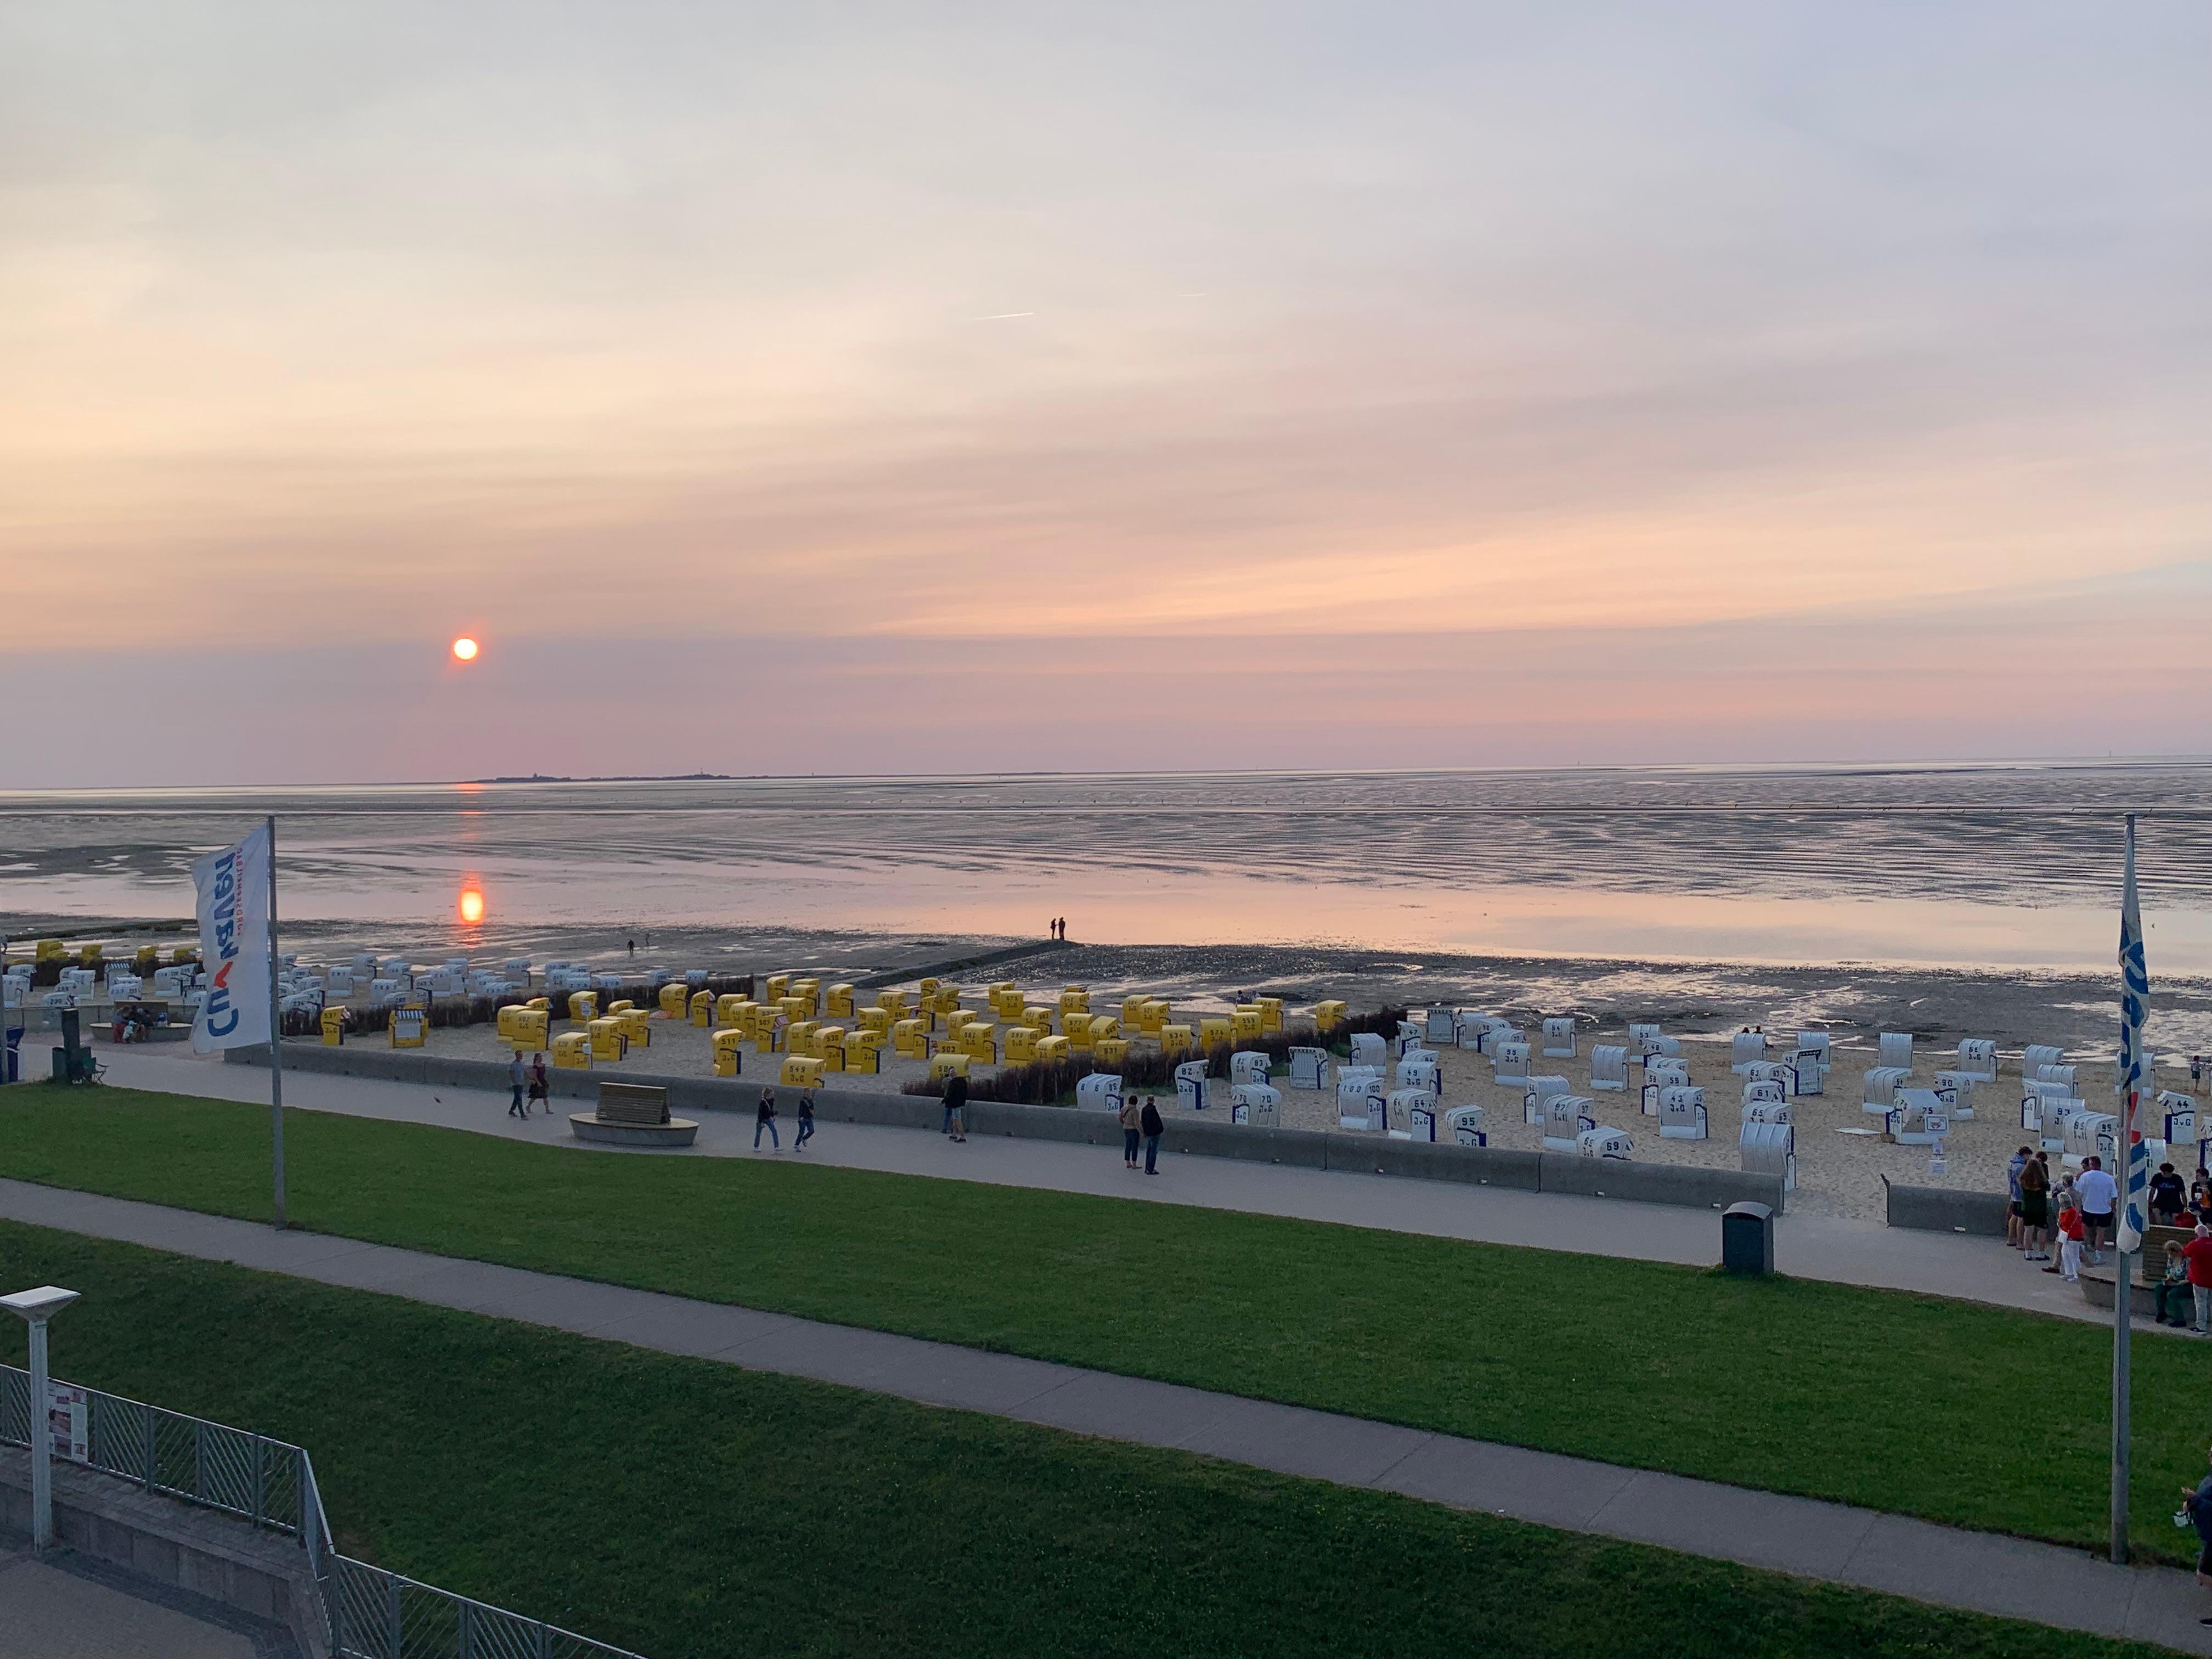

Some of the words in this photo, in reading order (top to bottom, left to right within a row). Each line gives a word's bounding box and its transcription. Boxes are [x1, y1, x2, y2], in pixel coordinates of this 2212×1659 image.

[1369, 1085, 1380, 1093] 100
[1757, 1089, 1769, 1098] 61
[1261, 1095, 1272, 1103] 70
[1414, 1099, 1425, 1108] 64
[2177, 1100, 2189, 1109] 44
[1752, 1108, 1764, 1117] 65
[1462, 1117, 1475, 1126] 95
[2102, 1124, 2112, 1132] 99
[1607, 1141, 1620, 1151] 69
